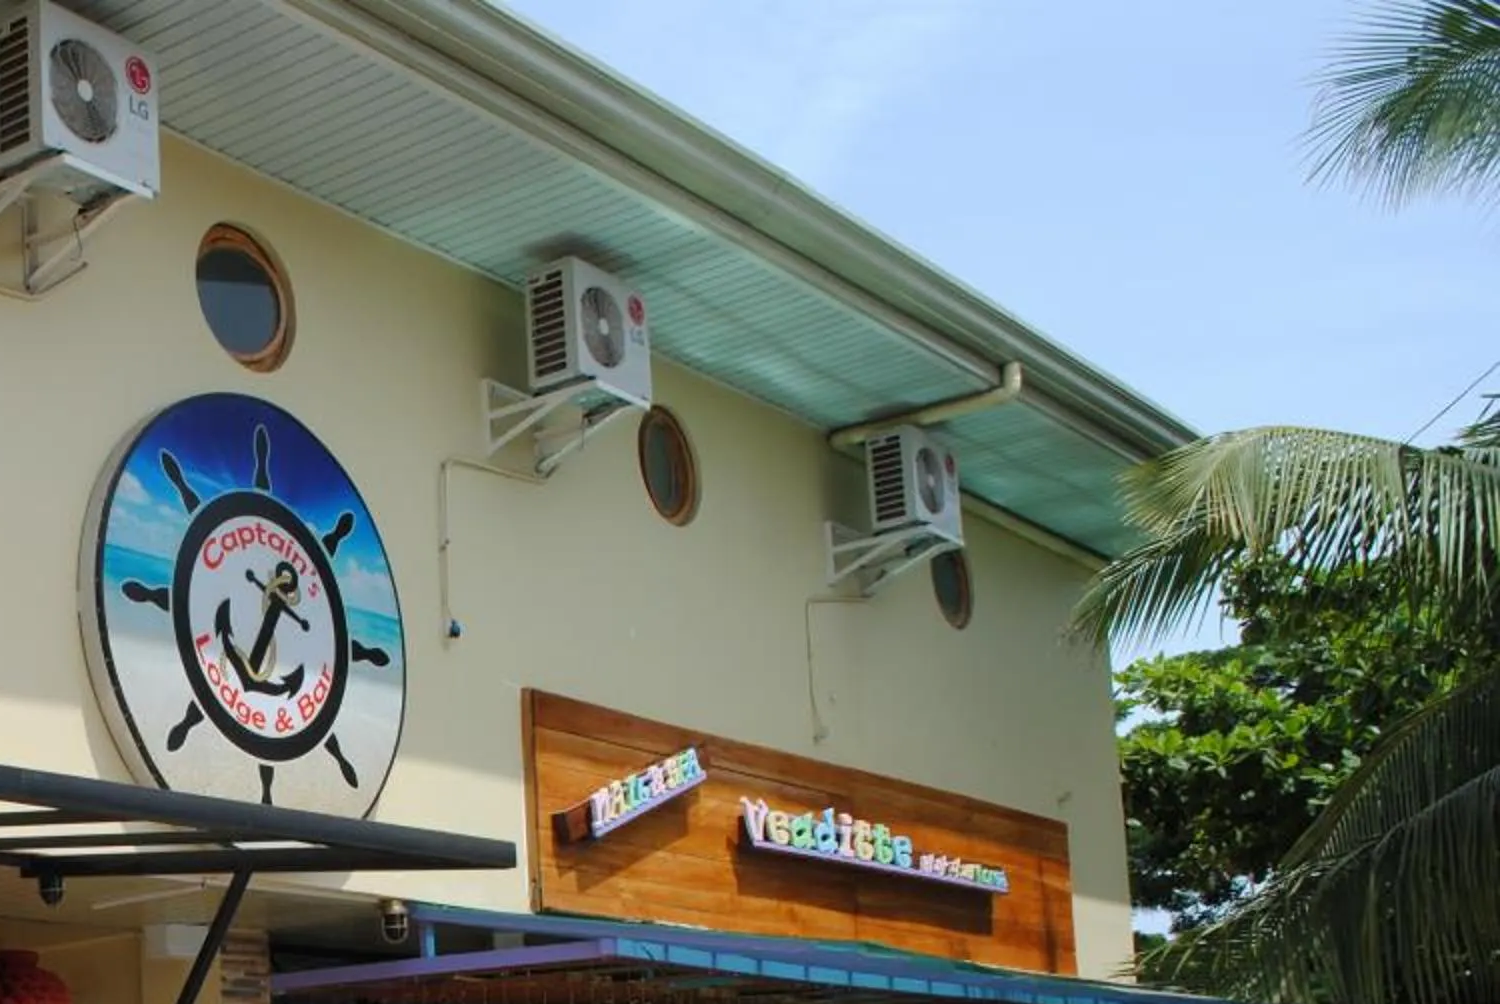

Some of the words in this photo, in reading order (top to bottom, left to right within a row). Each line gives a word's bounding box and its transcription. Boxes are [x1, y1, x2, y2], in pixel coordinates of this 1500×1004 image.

[128, 94, 150, 121] LG
[202, 522, 320, 598] Captain's
[196, 634, 266, 730] Lodge
[274, 709, 295, 733] &
[298, 663, 333, 721] Bar
